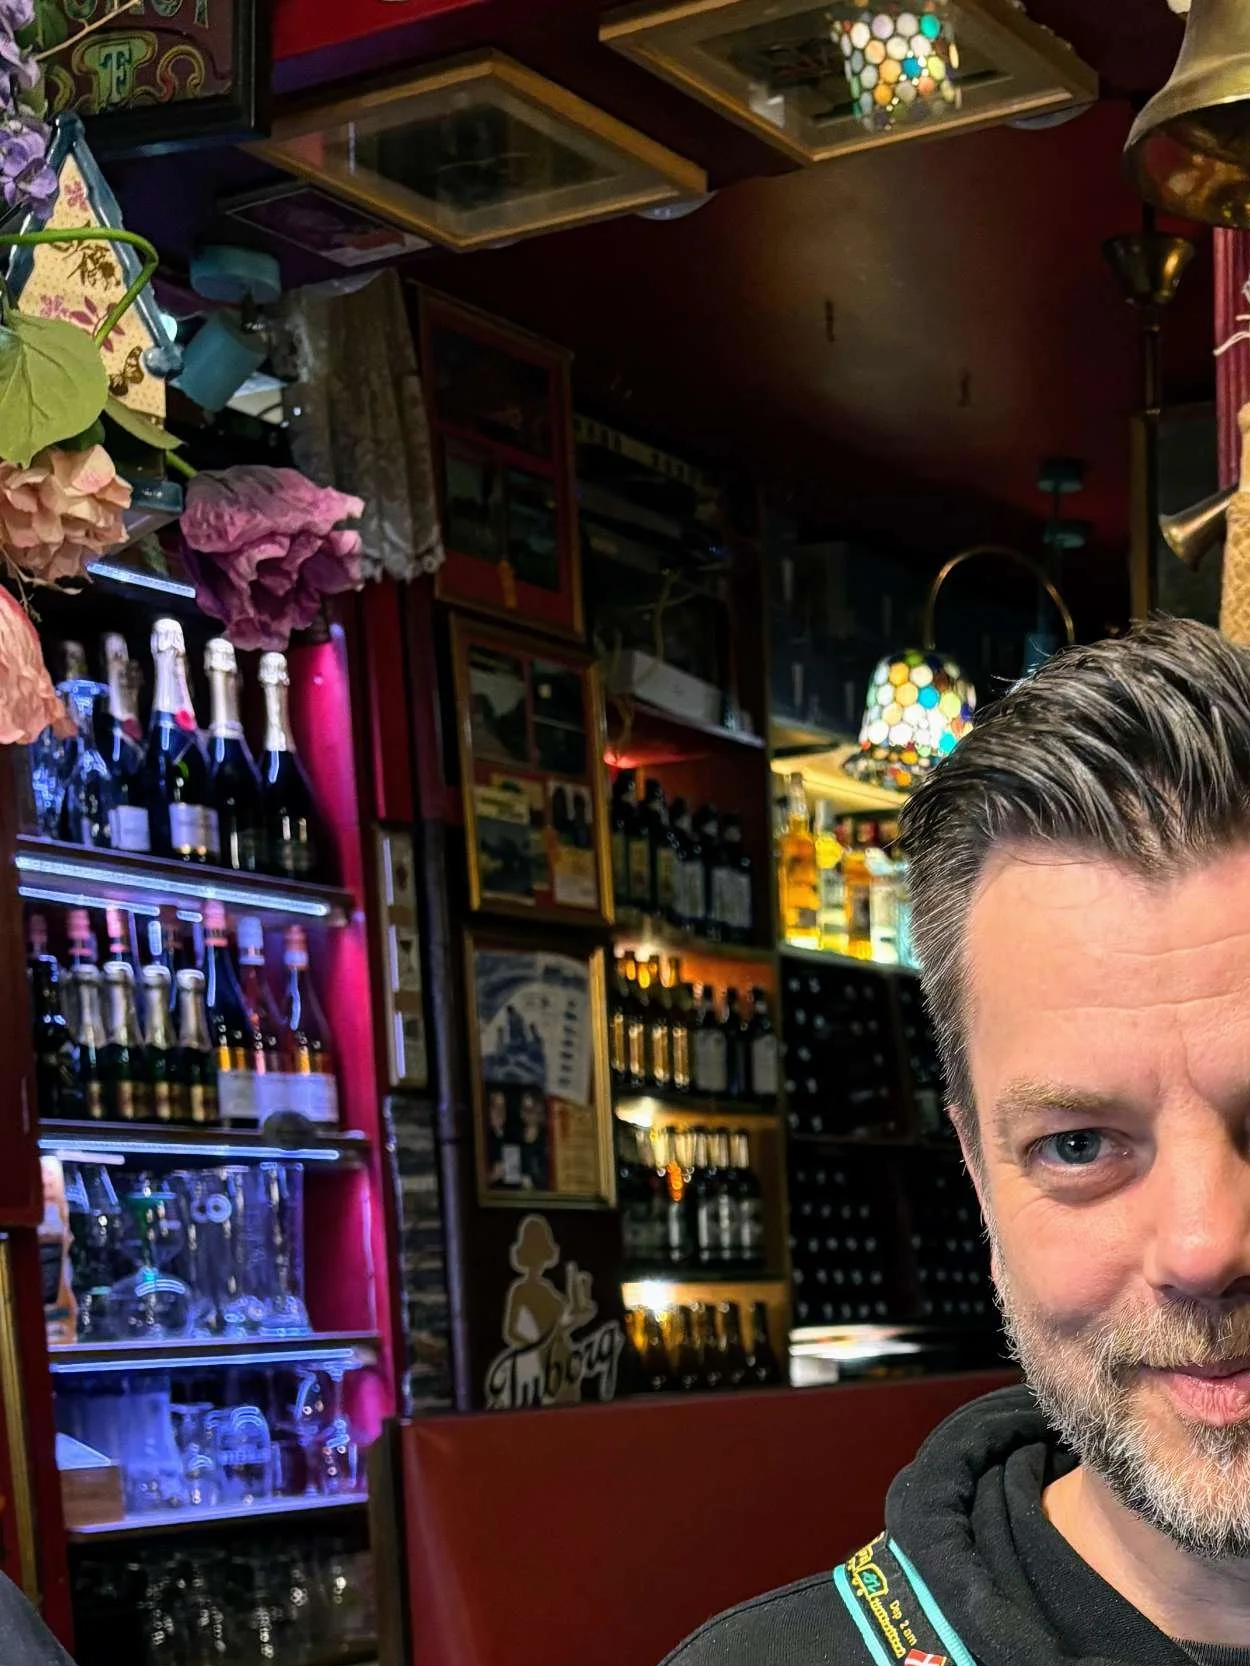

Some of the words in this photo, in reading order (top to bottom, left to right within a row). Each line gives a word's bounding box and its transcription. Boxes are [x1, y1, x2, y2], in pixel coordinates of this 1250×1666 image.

[890, 1600, 902, 1619] Dep
[900, 1620, 909, 1629] 2
[903, 1629, 917, 1646] am
